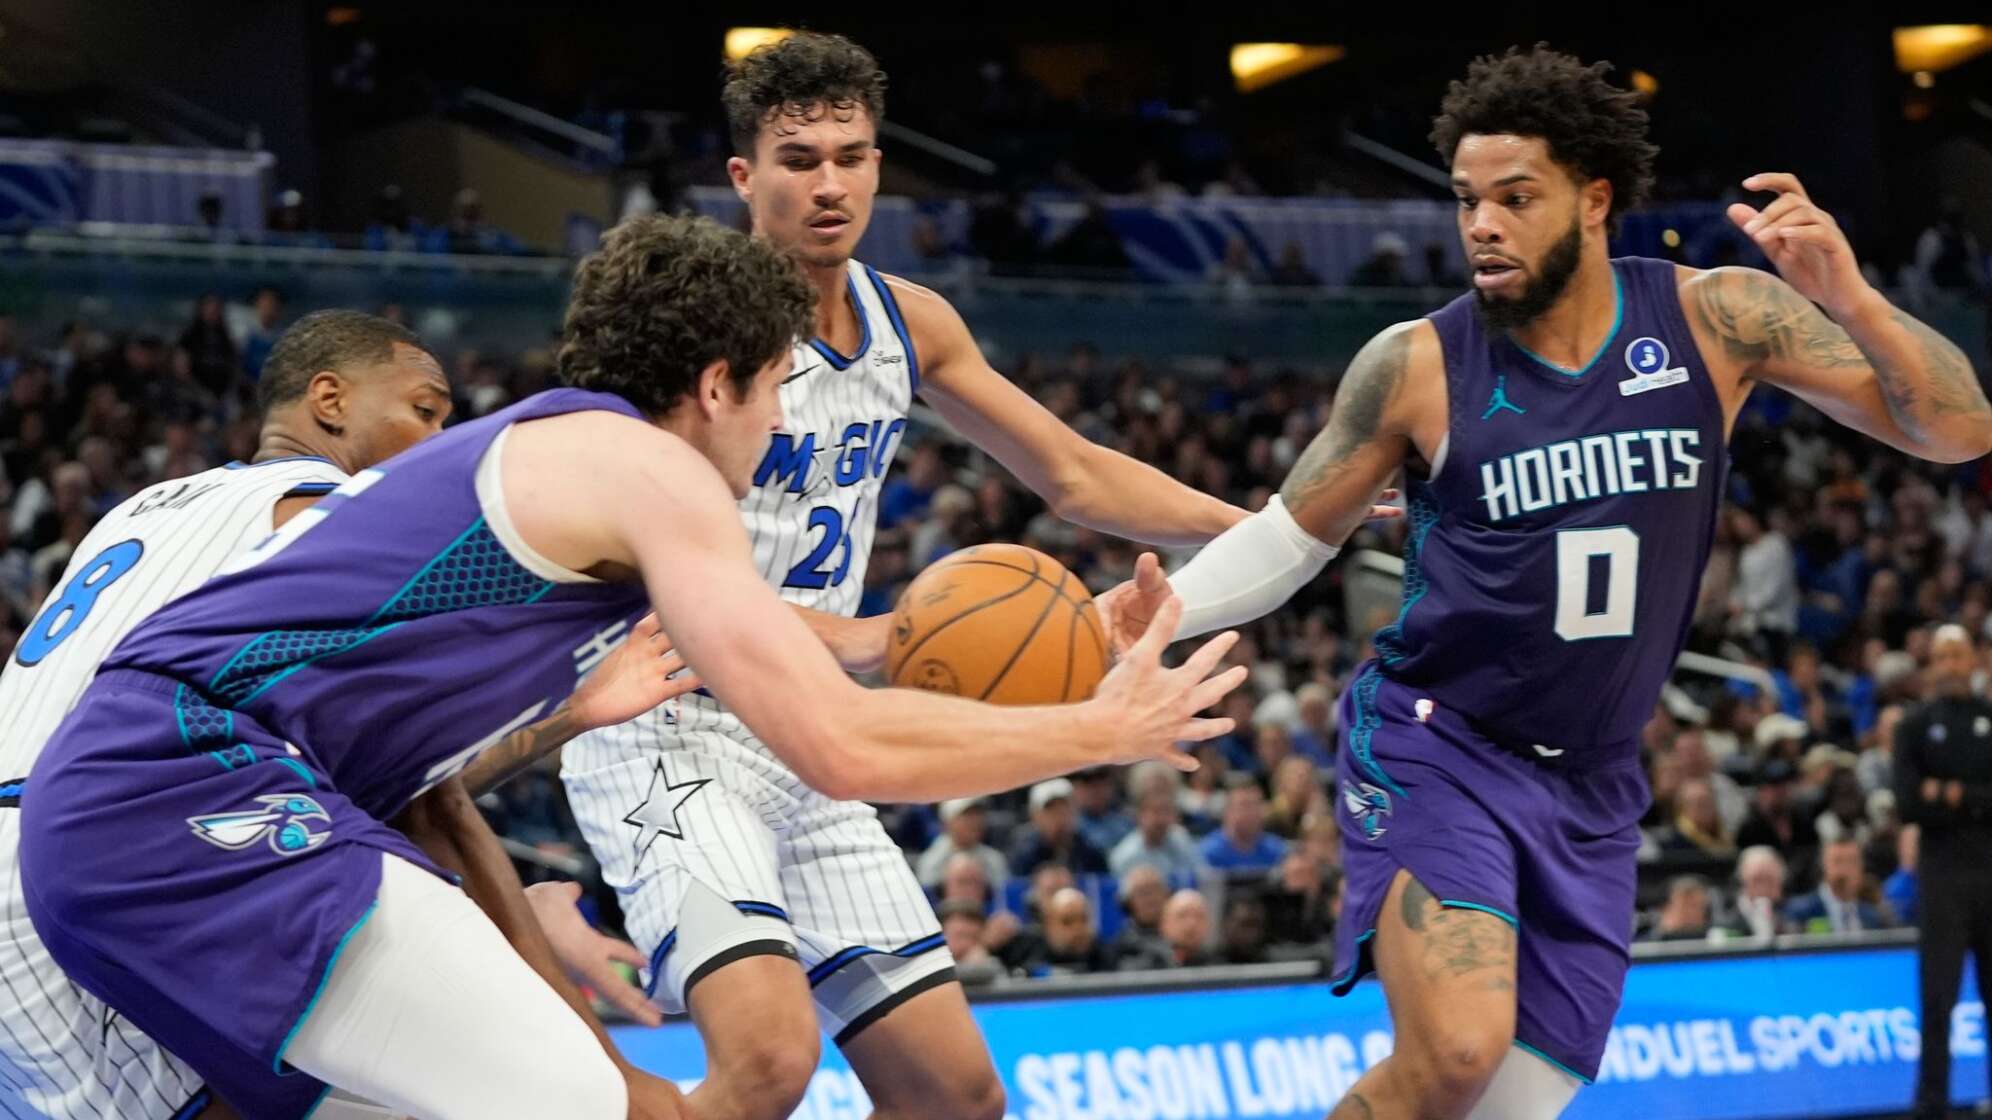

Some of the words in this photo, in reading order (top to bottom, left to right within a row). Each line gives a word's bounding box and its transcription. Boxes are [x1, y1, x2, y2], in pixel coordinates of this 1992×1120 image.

[1476, 428, 1706, 522] HORNETS
[15, 538, 144, 668] 8
[1554, 526, 1640, 642] 0
[1015, 1040, 1229, 1120] SEASON
[1222, 1032, 1362, 1118] LONG
[1597, 1017, 1755, 1083] NDUEL
[1750, 1006, 1922, 1071] SPORTS
